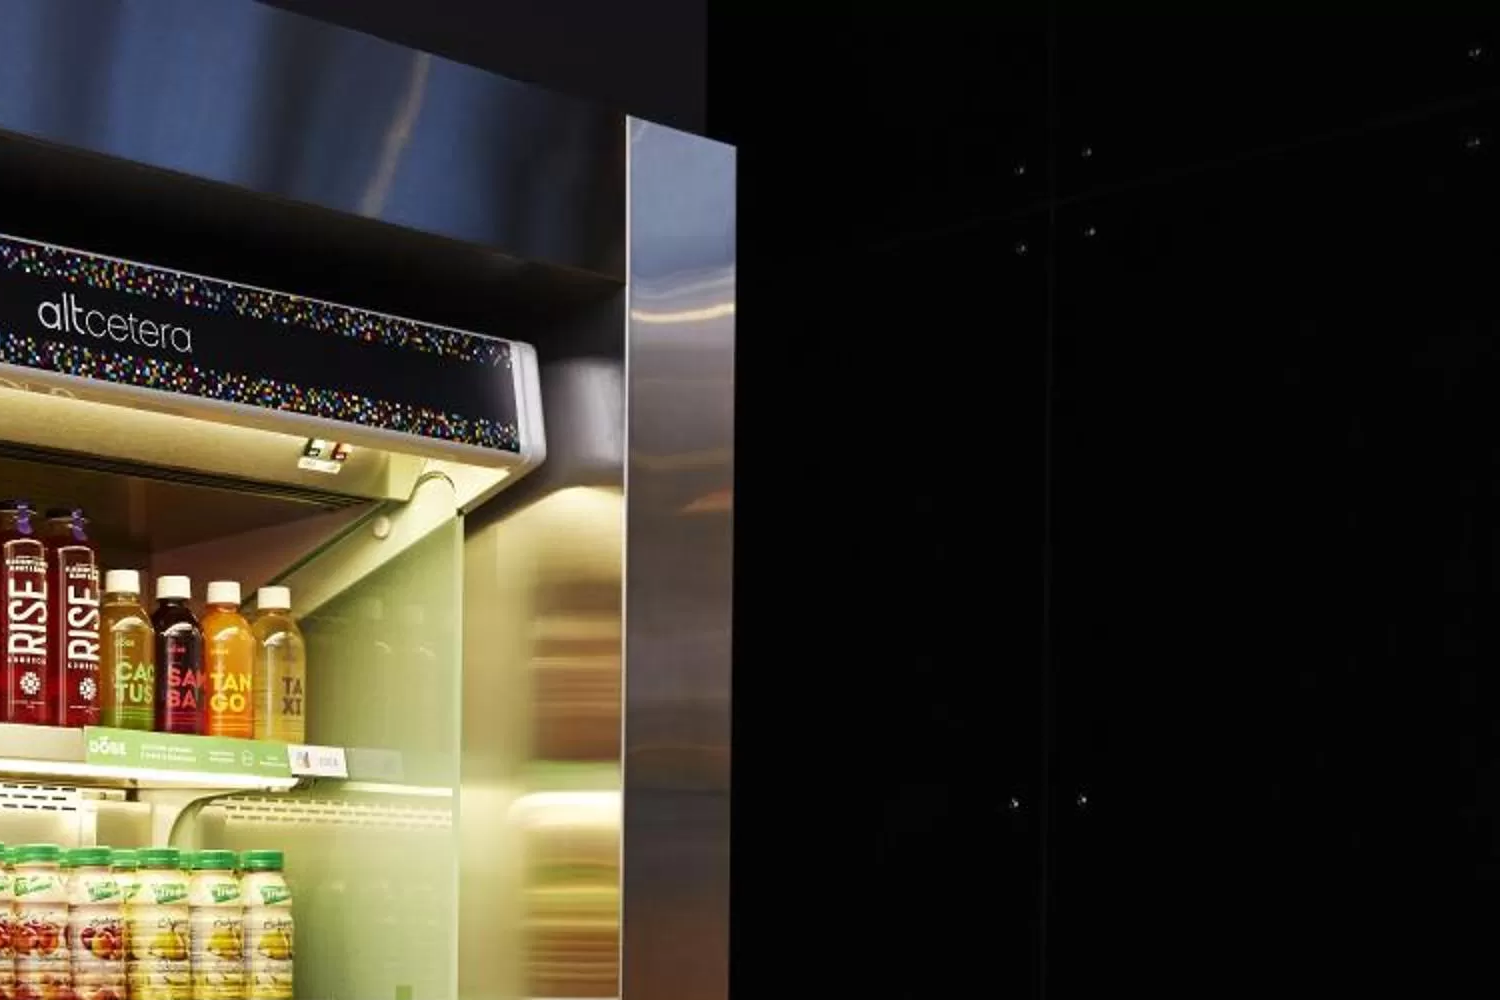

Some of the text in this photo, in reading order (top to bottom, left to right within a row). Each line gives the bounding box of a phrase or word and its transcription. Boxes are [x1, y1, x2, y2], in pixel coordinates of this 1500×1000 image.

[8, 578, 47, 656] RISE
[67, 585, 100, 661] RISE
[210, 672, 252, 692] TAN
[282, 675, 303, 695] TA
[115, 682, 153, 704] TUS
[168, 688, 197, 709] BA
[210, 693, 245, 713] GO
[282, 697, 301, 716] XI
